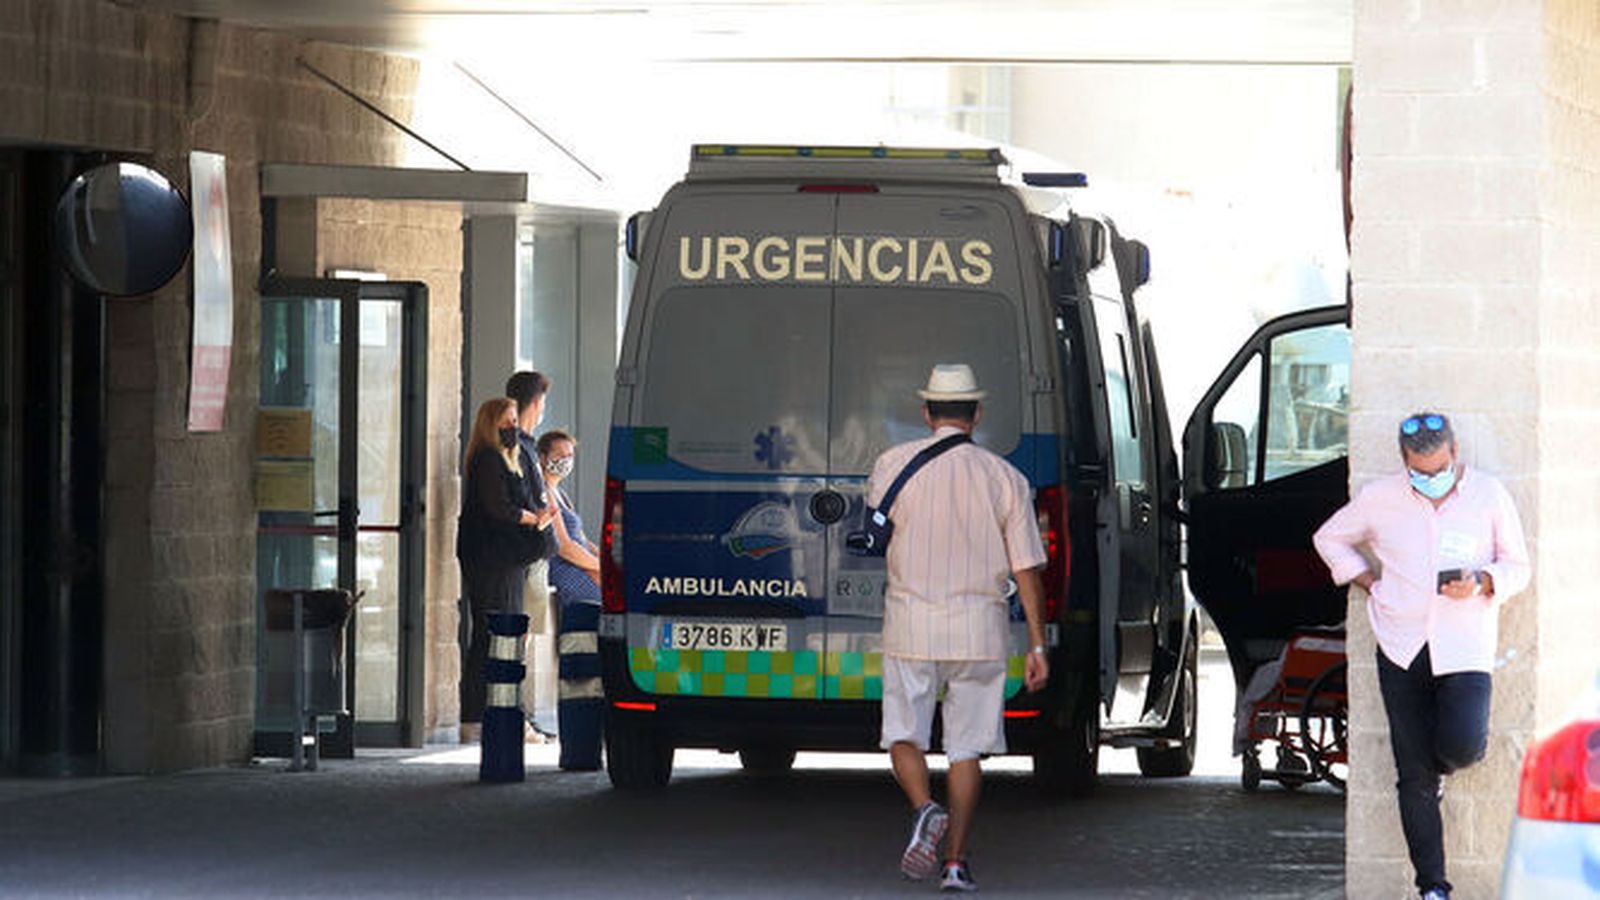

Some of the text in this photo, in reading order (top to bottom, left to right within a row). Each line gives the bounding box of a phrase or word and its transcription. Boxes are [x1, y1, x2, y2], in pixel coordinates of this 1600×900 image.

[679, 237, 993, 285] URGENCIAS
[645, 577, 807, 598] AMBULANCIA
[679, 625, 733, 649] 3786
